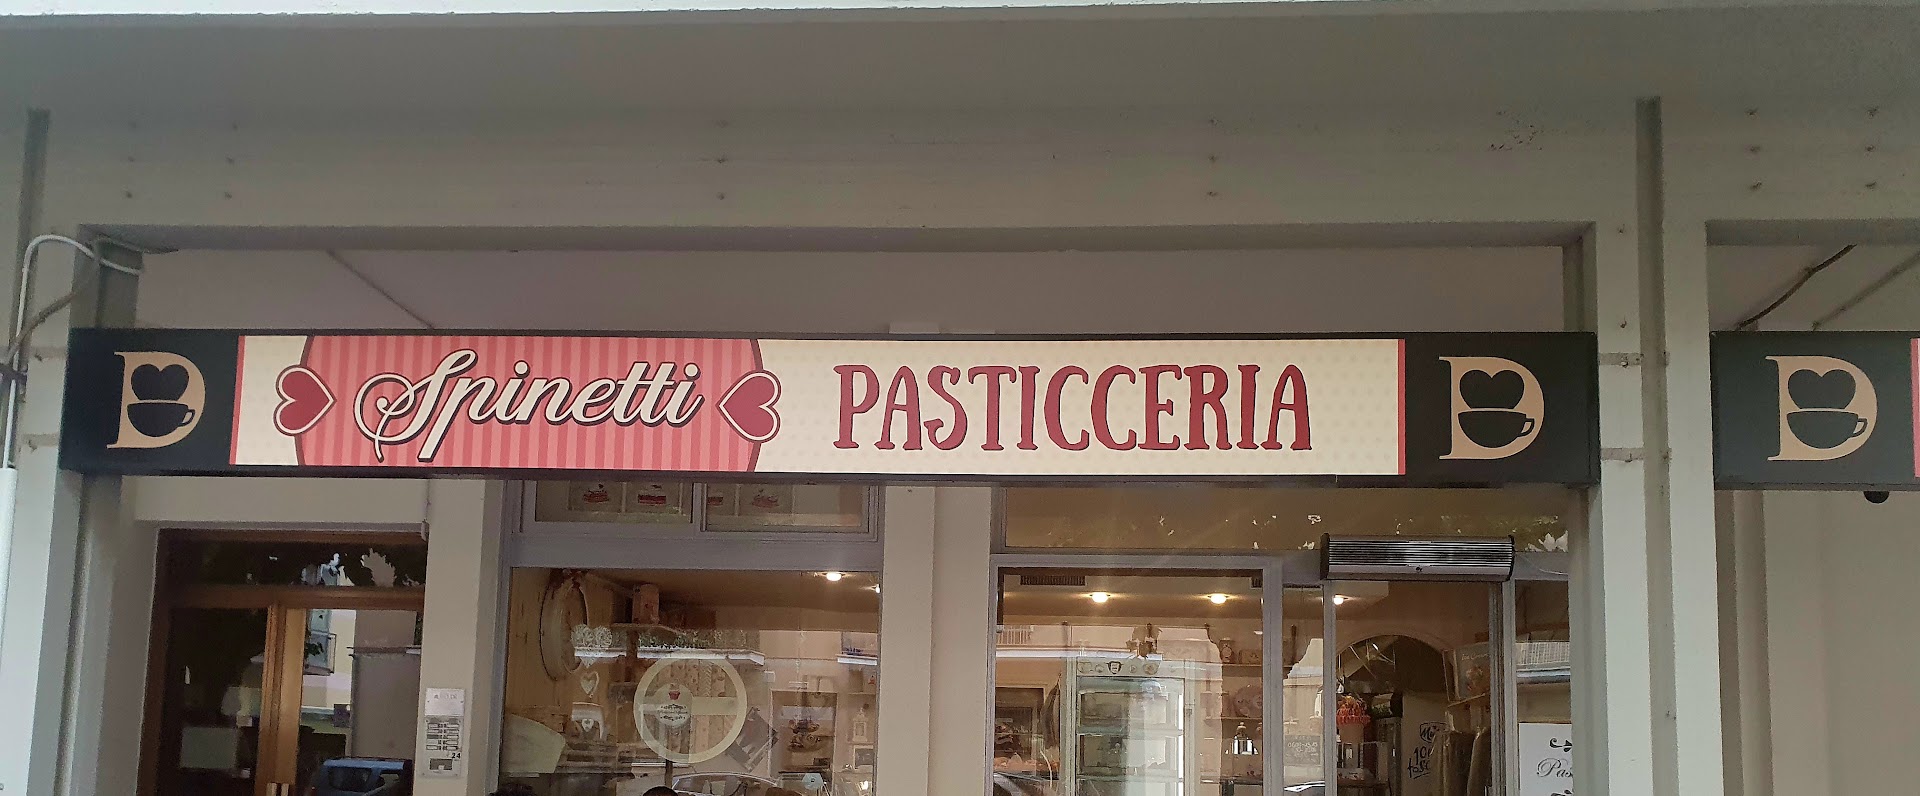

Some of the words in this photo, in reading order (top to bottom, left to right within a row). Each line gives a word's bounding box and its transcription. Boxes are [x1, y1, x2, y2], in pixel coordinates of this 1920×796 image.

[107, 351, 206, 449] D
[353, 349, 705, 463] Spinetti
[833, 364, 1312, 451] PASTICCERIA
[1439, 356, 1545, 460] D
[1765, 355, 1878, 461] D
